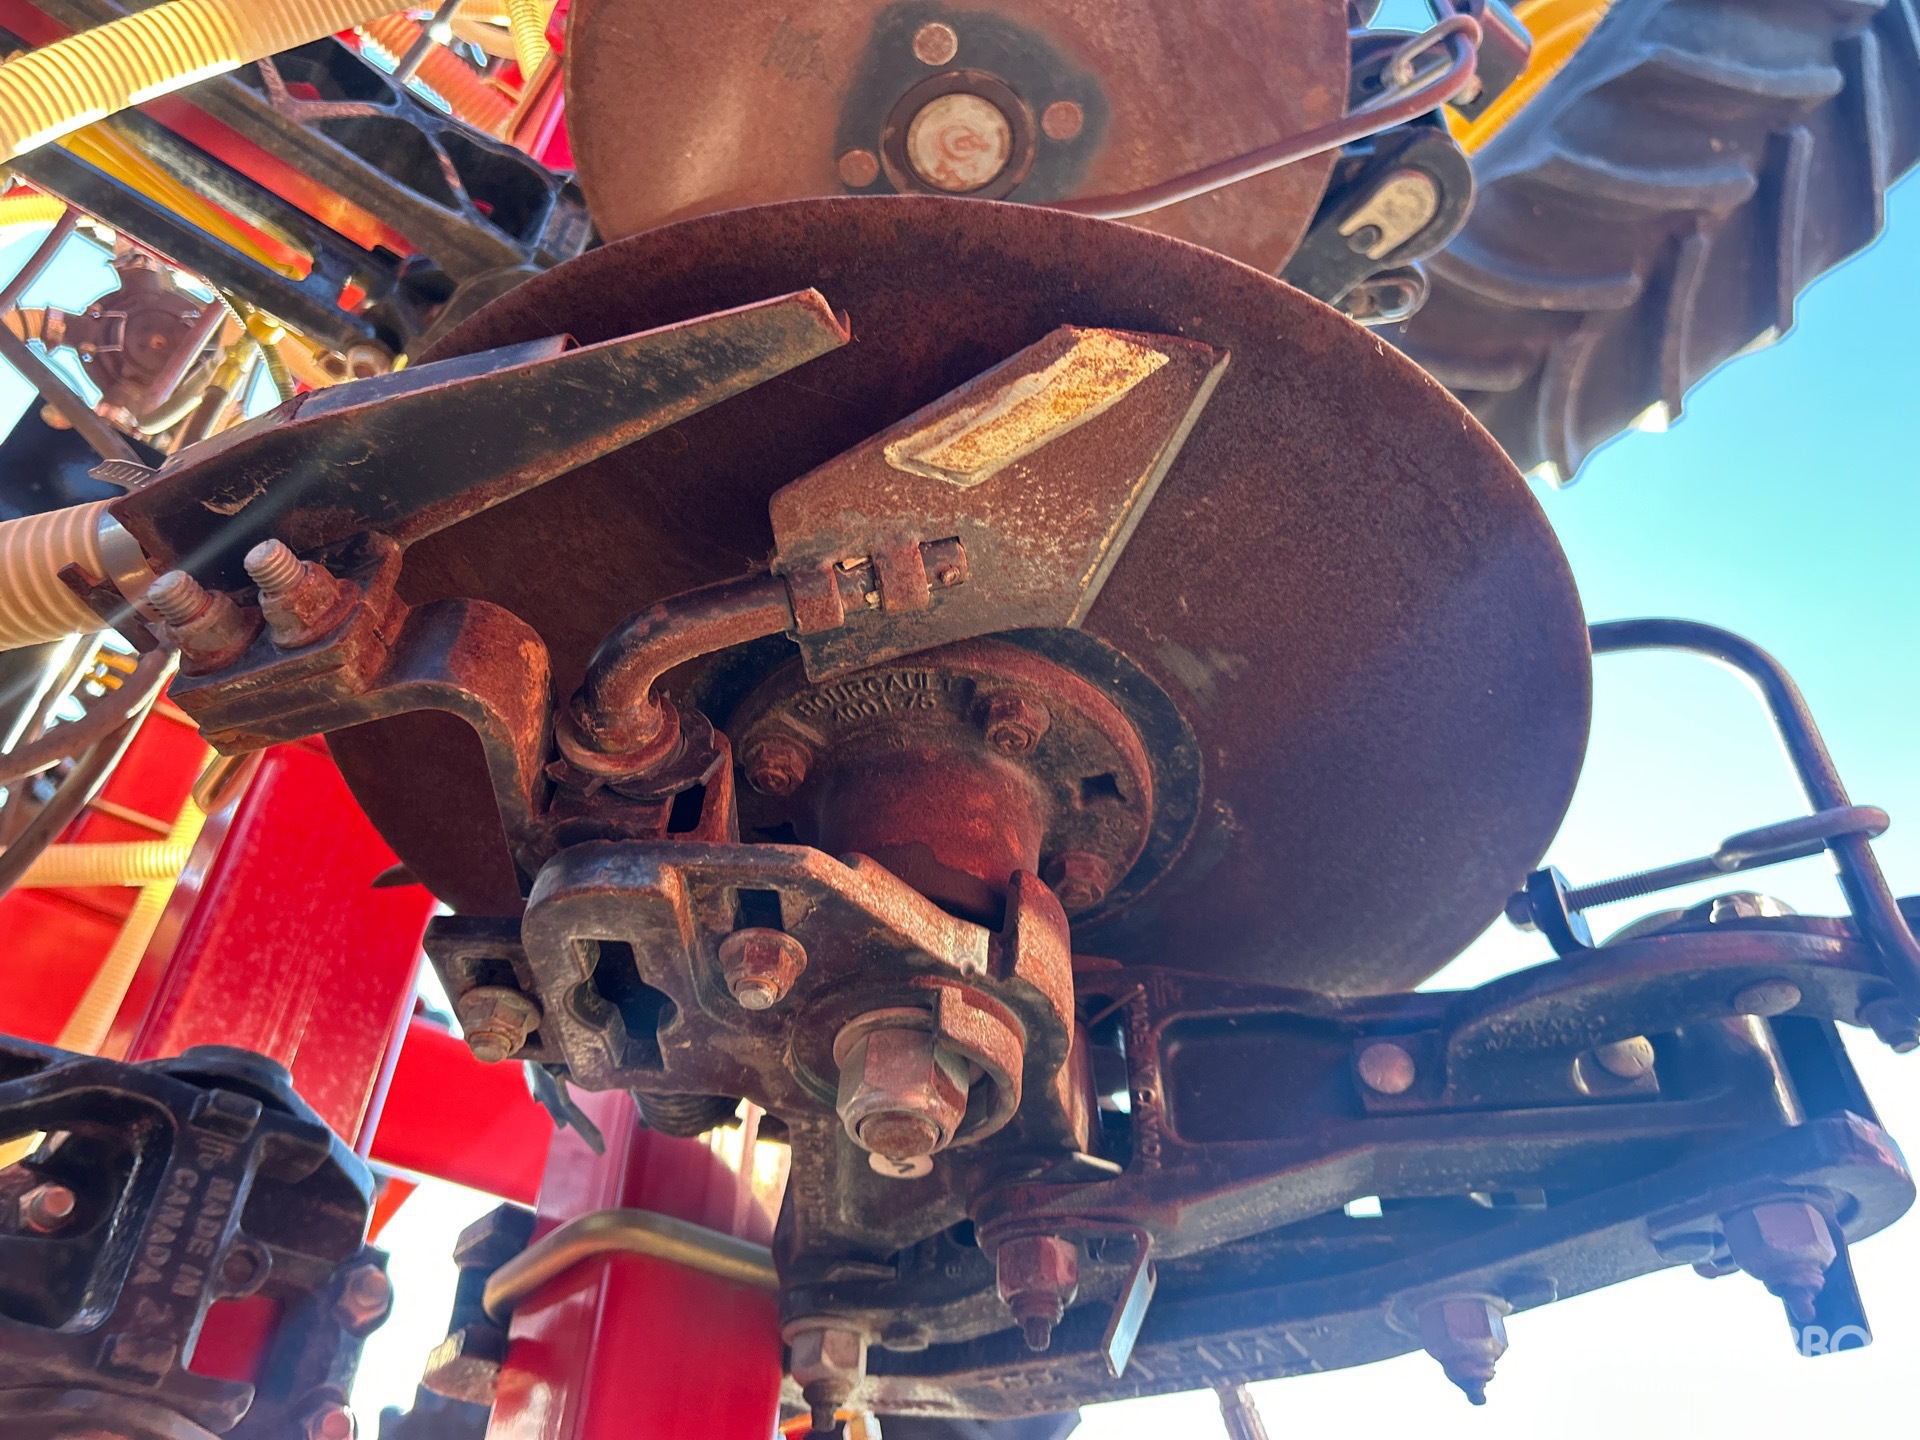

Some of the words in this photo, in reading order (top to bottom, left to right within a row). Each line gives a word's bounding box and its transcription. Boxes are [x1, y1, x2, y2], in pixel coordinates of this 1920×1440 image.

[132, 1167, 199, 1285] CANADA
[185, 1176, 236, 1257] MADE
[171, 1263, 204, 1297] IN
